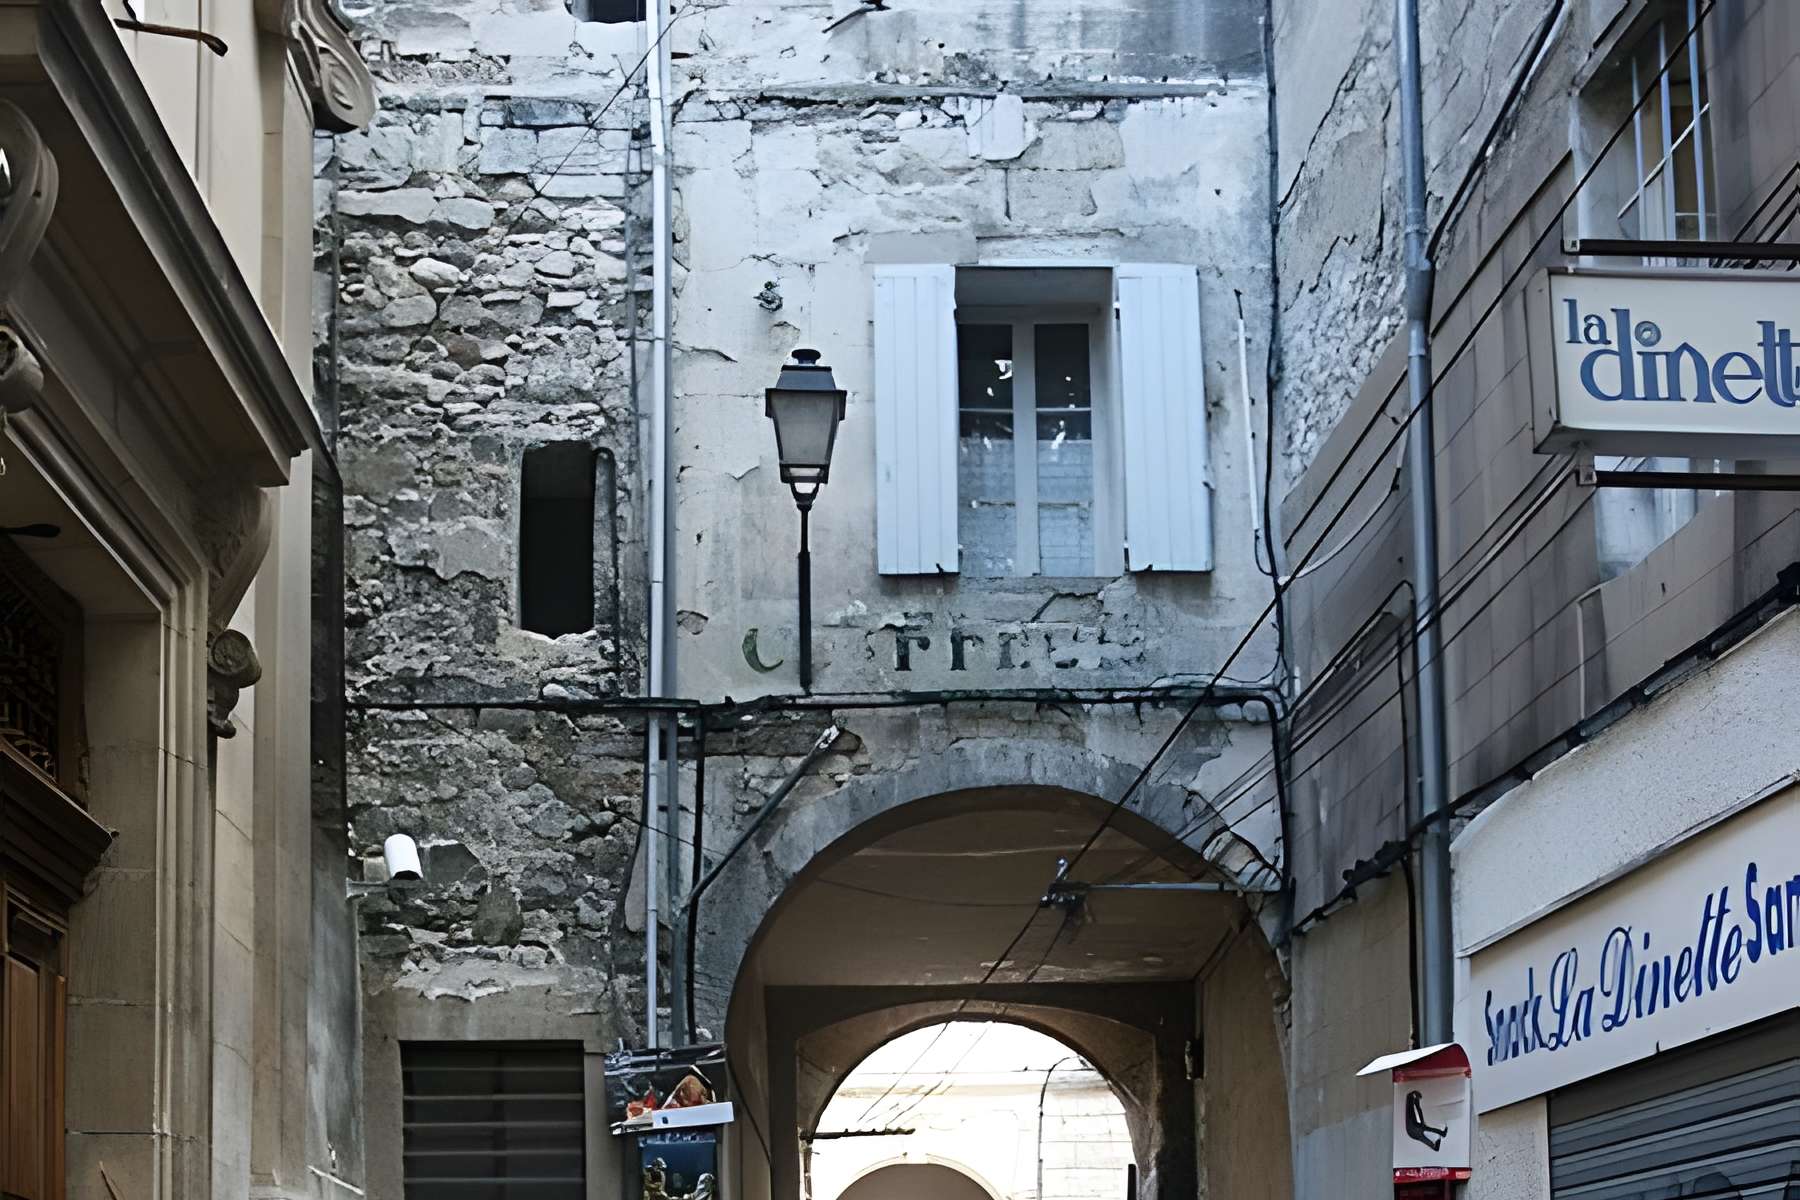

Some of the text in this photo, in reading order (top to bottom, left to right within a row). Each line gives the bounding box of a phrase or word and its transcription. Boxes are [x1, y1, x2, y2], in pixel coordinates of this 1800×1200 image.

[1563, 298, 1612, 345] la
[1580, 308, 1800, 408] dinett
[1548, 948, 1594, 1051] La
[1600, 886, 1742, 1032] Dinette
